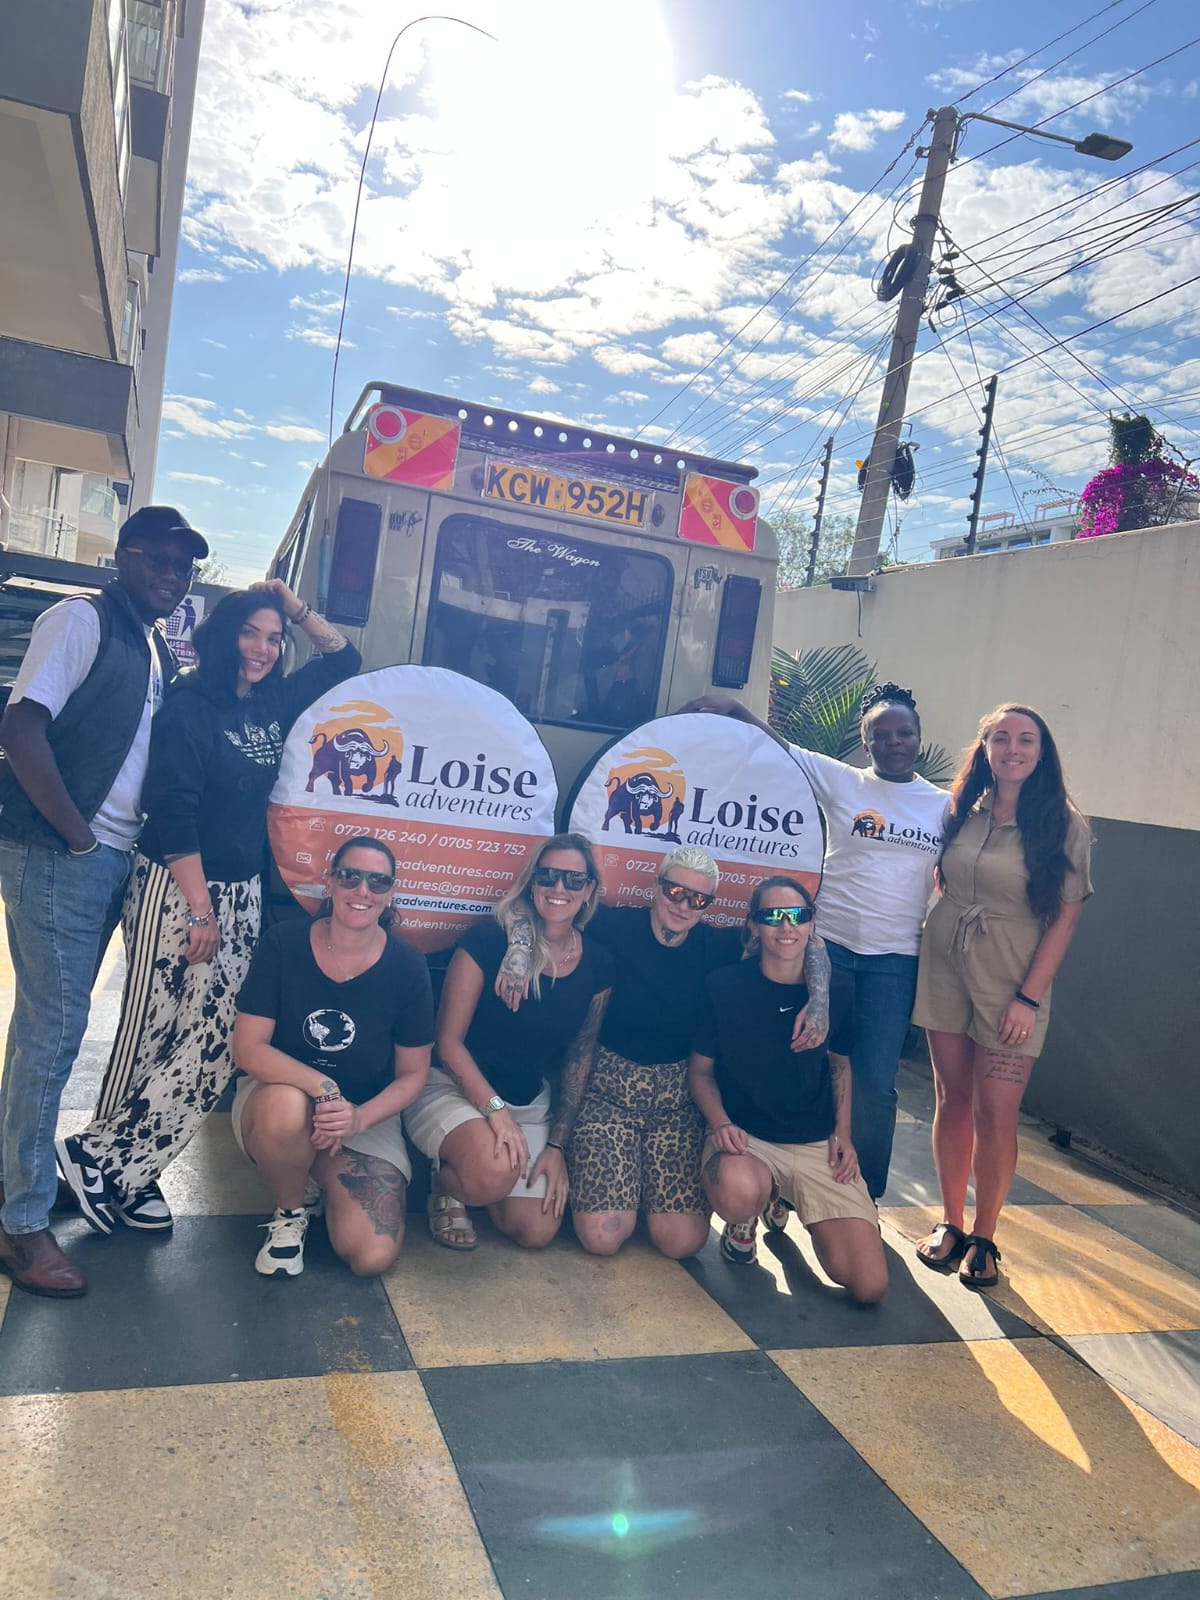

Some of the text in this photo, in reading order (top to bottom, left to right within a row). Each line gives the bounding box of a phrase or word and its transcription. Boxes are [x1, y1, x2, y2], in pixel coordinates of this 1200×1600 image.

[488, 465, 649, 523] KCW 952H
[506, 537, 600, 567] The Wagon
[407, 744, 538, 799] Loise
[405, 789, 534, 822] adventures
[688, 786, 804, 836] Loise
[334, 823, 370, 838] 0722
[374, 828, 397, 841] 126
[399, 831, 427, 845] 240
[438, 836, 473, 850] 0705
[476, 840, 501, 853] 723
[503, 843, 526, 856] 752
[686, 827, 800, 858] adventures
[887, 836, 938, 855] adventures
[888, 822, 940, 847] Loise
[626, 859, 656, 873] 0722
[392, 895, 493, 914] eadventures.com
